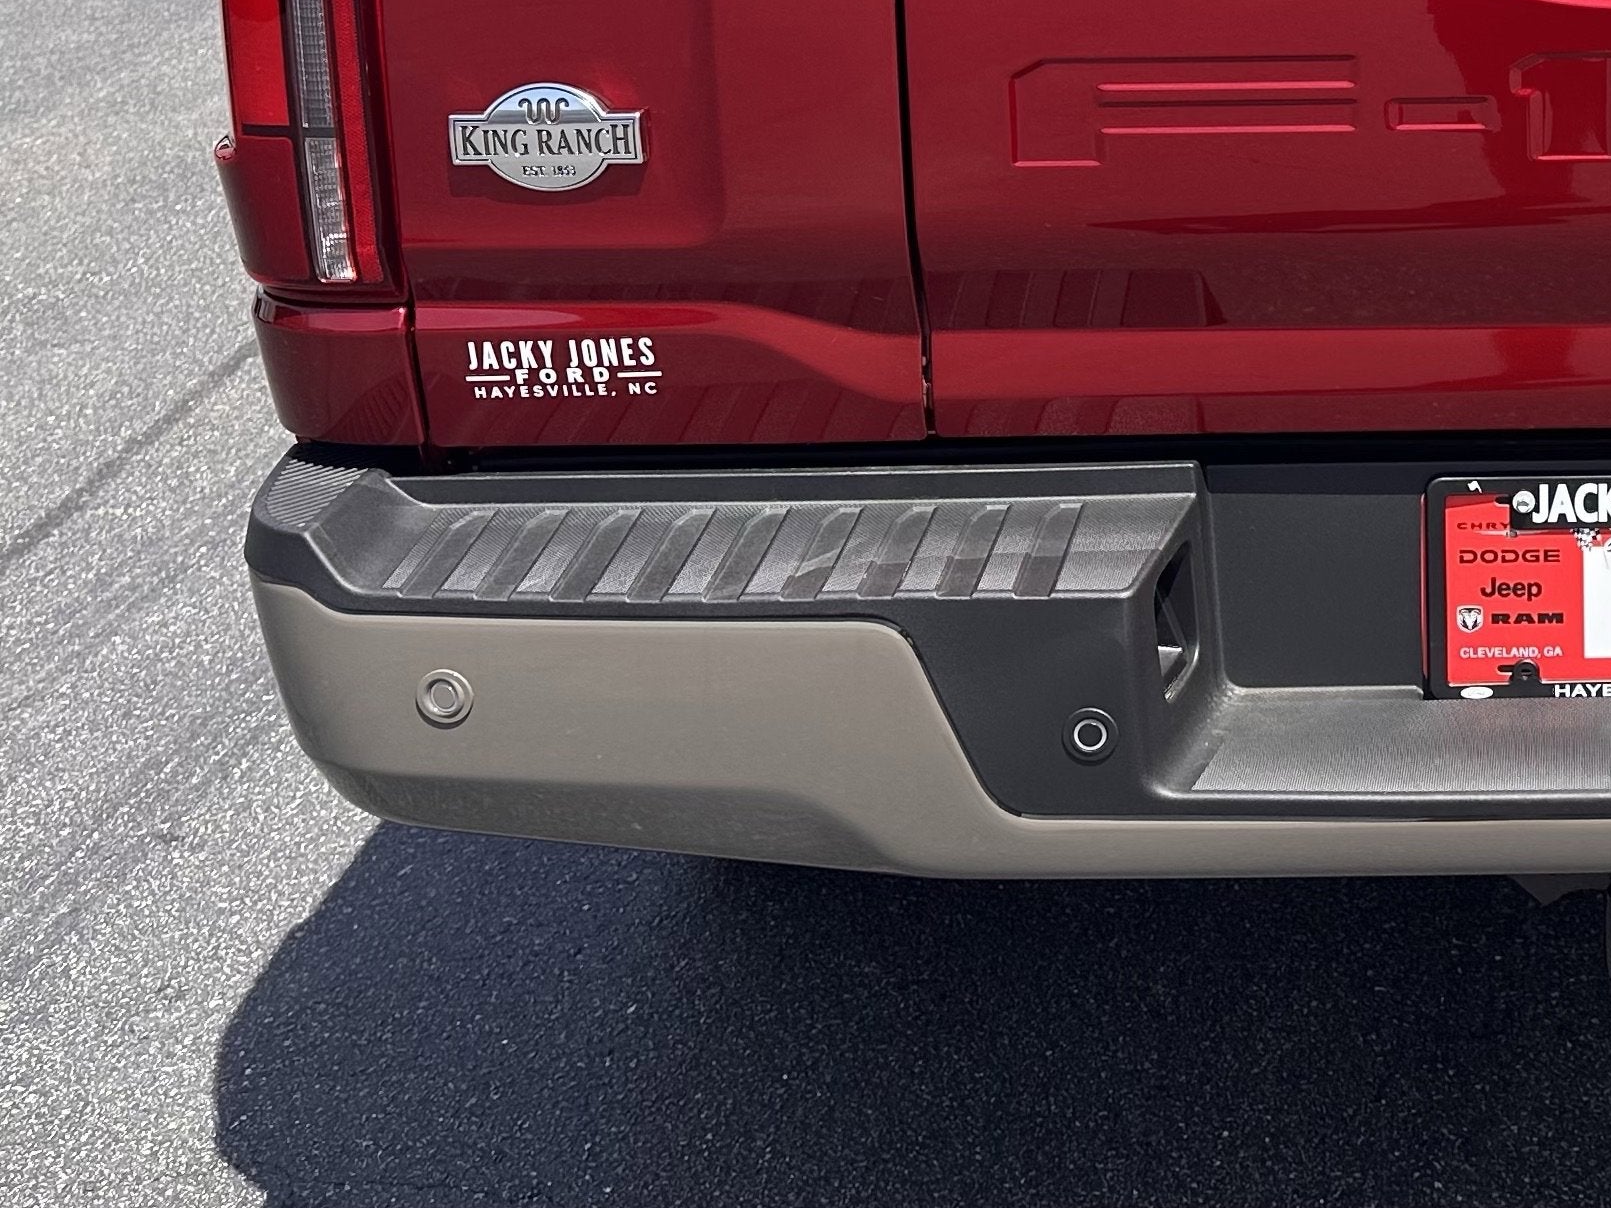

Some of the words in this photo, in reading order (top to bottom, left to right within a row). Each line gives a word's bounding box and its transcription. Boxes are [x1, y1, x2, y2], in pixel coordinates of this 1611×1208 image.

[460, 125, 529, 157] KING
[536, 123, 632, 156] RANCH
[467, 340, 553, 370] JACKY
[568, 337, 655, 367] JONES
[515, 366, 610, 384] FORD
[474, 383, 617, 399] HAYESVILLE,
[628, 382, 658, 395] NC
[1458, 549, 1561, 564] DODGE
[1480, 577, 1542, 602] Jeep
[1491, 612, 1564, 625] RAM
[1459, 647, 1541, 659] CLEVELAND,
[1543, 646, 1563, 657] GA
